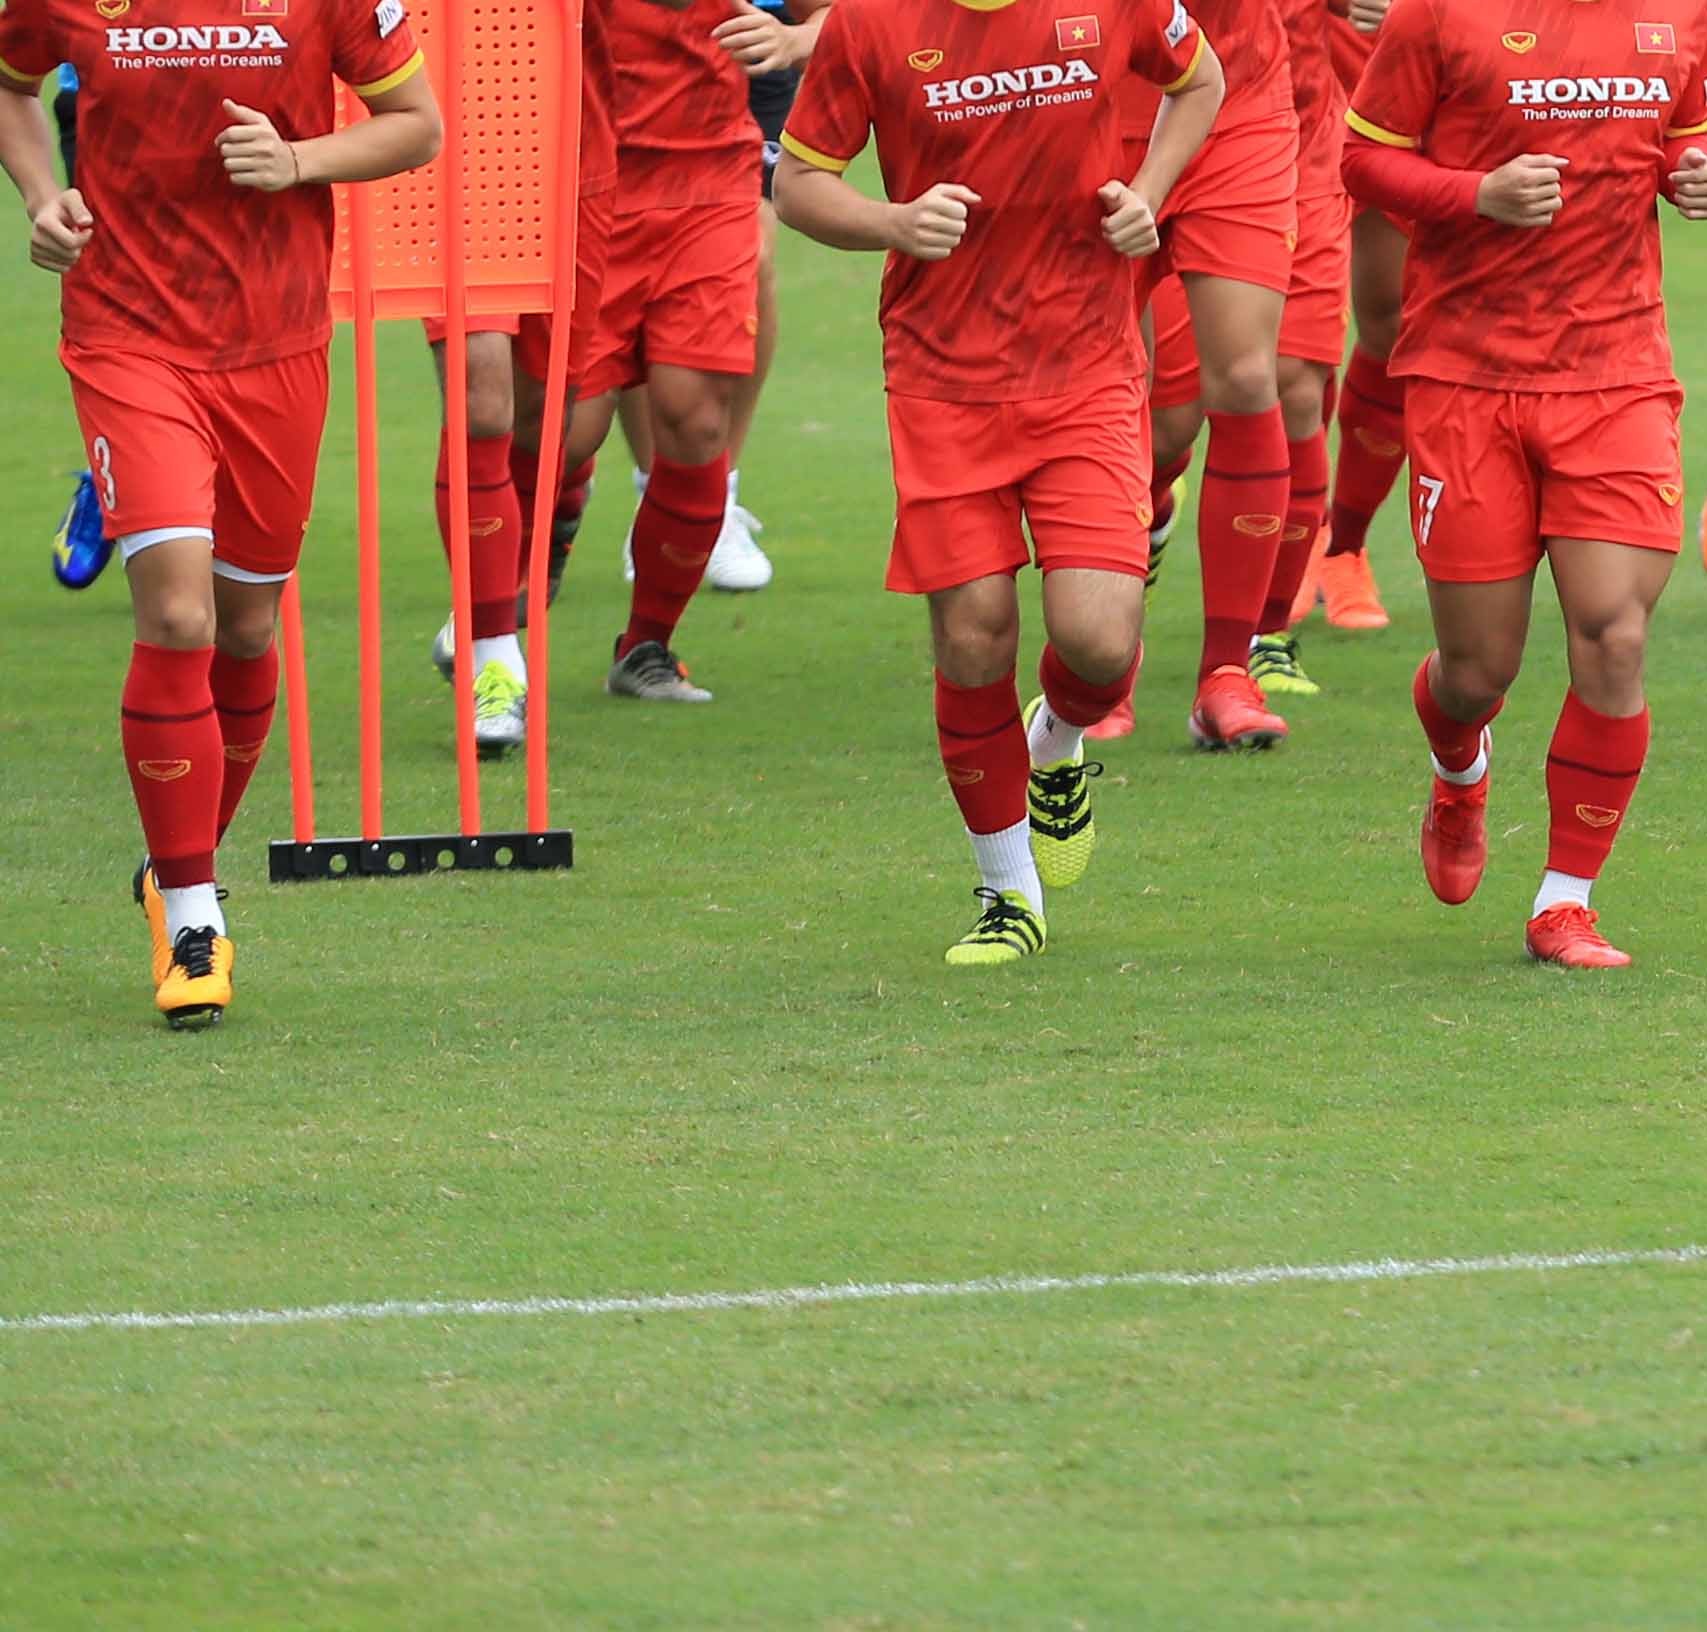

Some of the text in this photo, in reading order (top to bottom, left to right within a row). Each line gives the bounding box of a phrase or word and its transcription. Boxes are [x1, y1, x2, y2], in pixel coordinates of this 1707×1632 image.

[105, 25, 288, 52] HONDA
[112, 53, 283, 69] The Power of Dreams
[922, 59, 1098, 108] HONDA
[1507, 77, 1671, 104] HONDA
[934, 88, 1093, 123] The Power of Dreams
[1521, 105, 1660, 121] The Power of Dreams
[94, 436, 115, 510] 3
